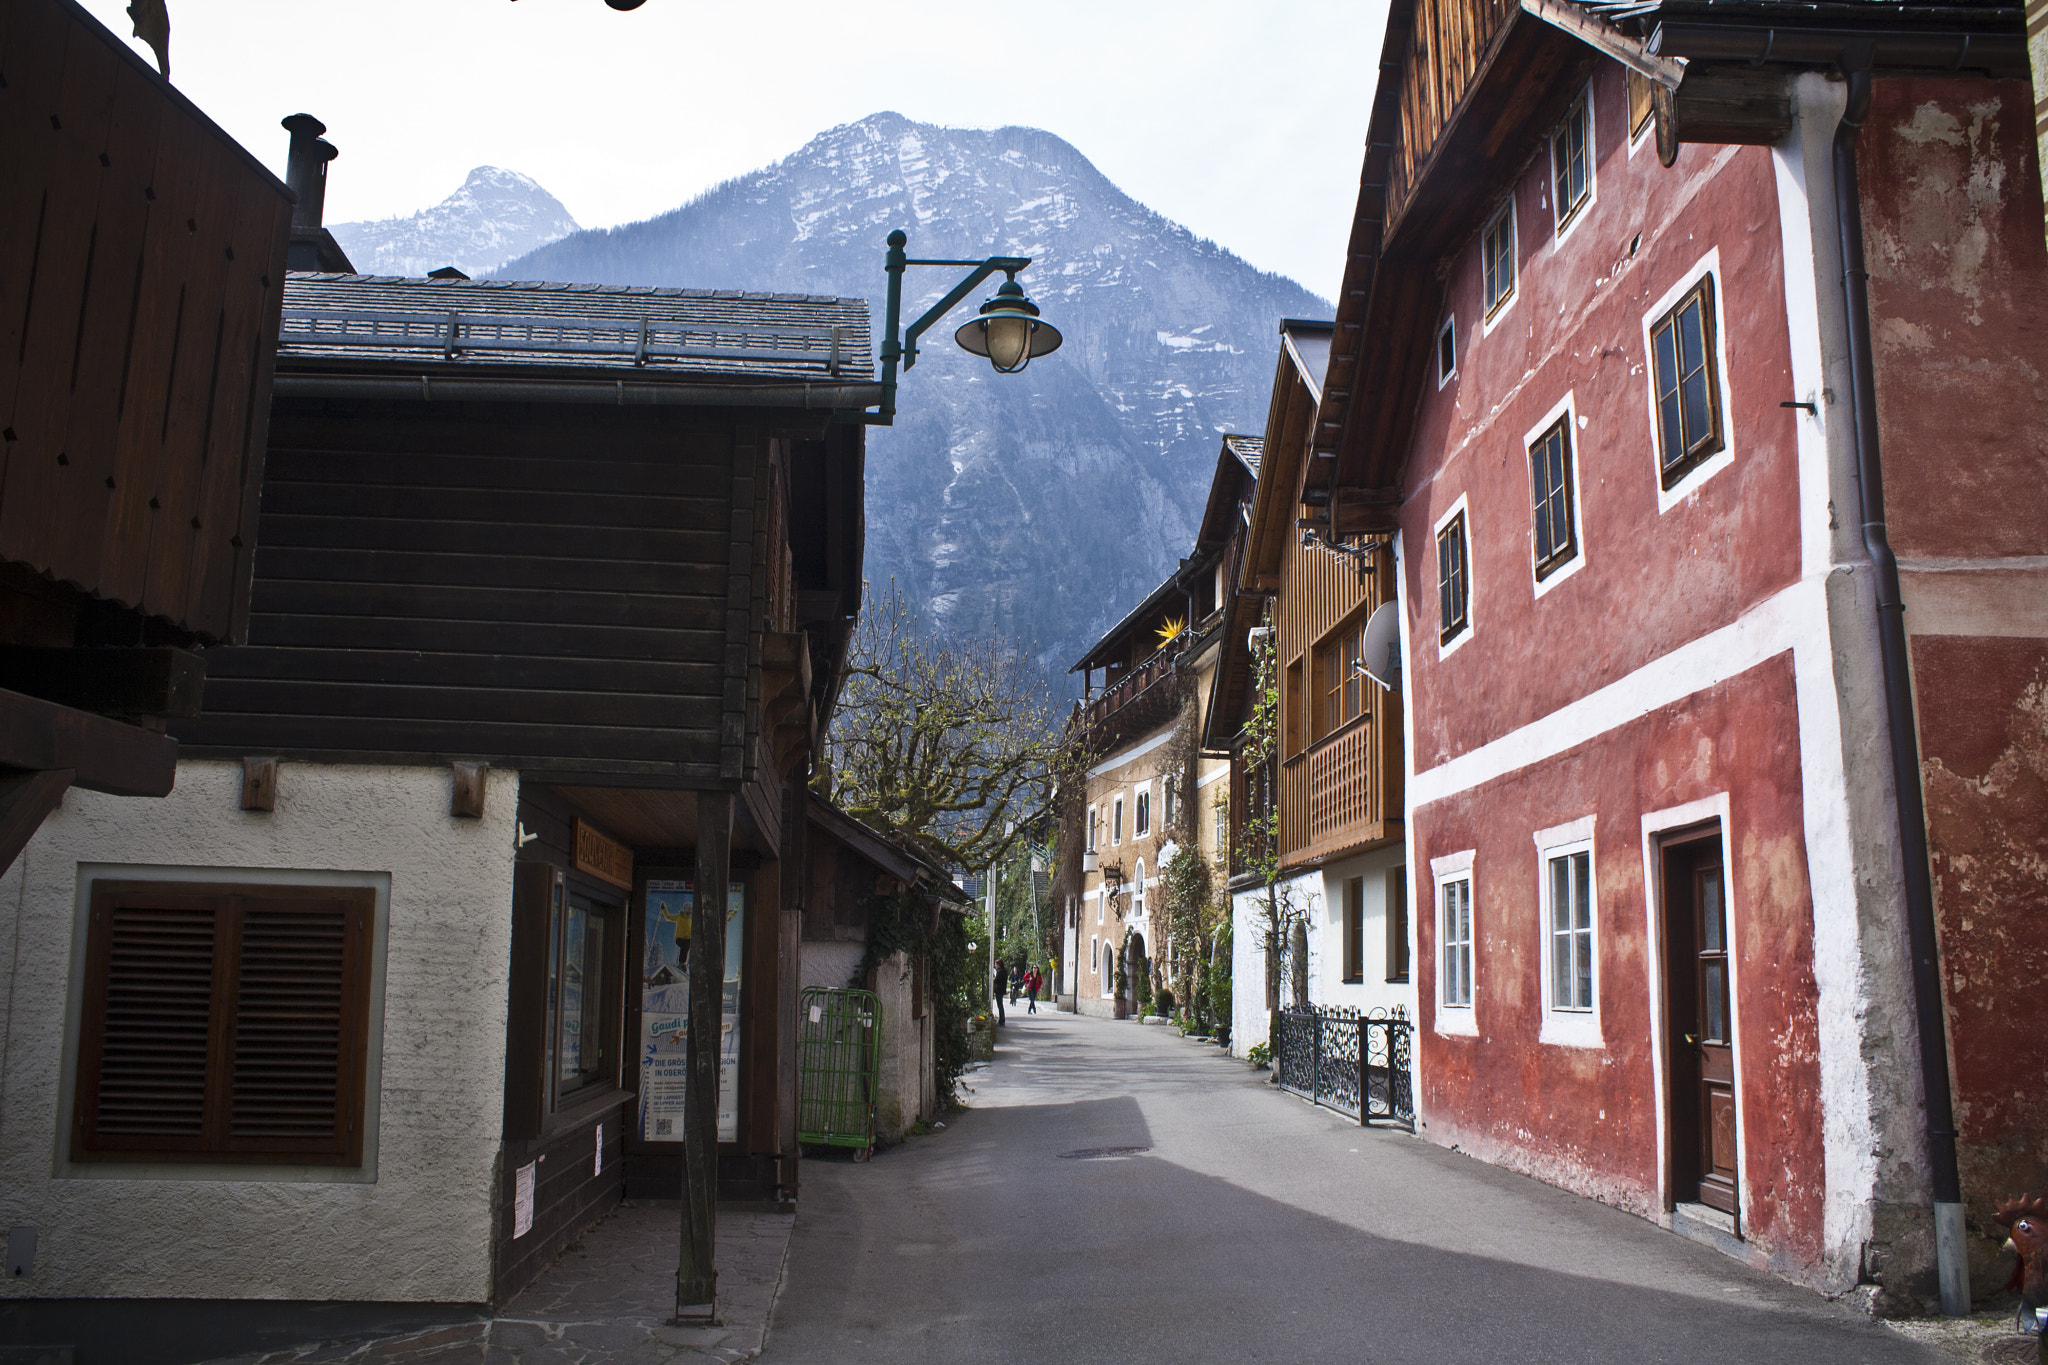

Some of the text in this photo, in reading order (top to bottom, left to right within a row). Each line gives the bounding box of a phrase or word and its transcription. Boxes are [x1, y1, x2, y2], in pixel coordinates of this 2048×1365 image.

[651, 1018, 680, 1034] Gaudi
[655, 1059, 666, 1067] DIE
[667, 1057, 686, 1066] GRÖS
[655, 1069, 662, 1077] IN
[663, 1067, 687, 1076] OBERÖ
